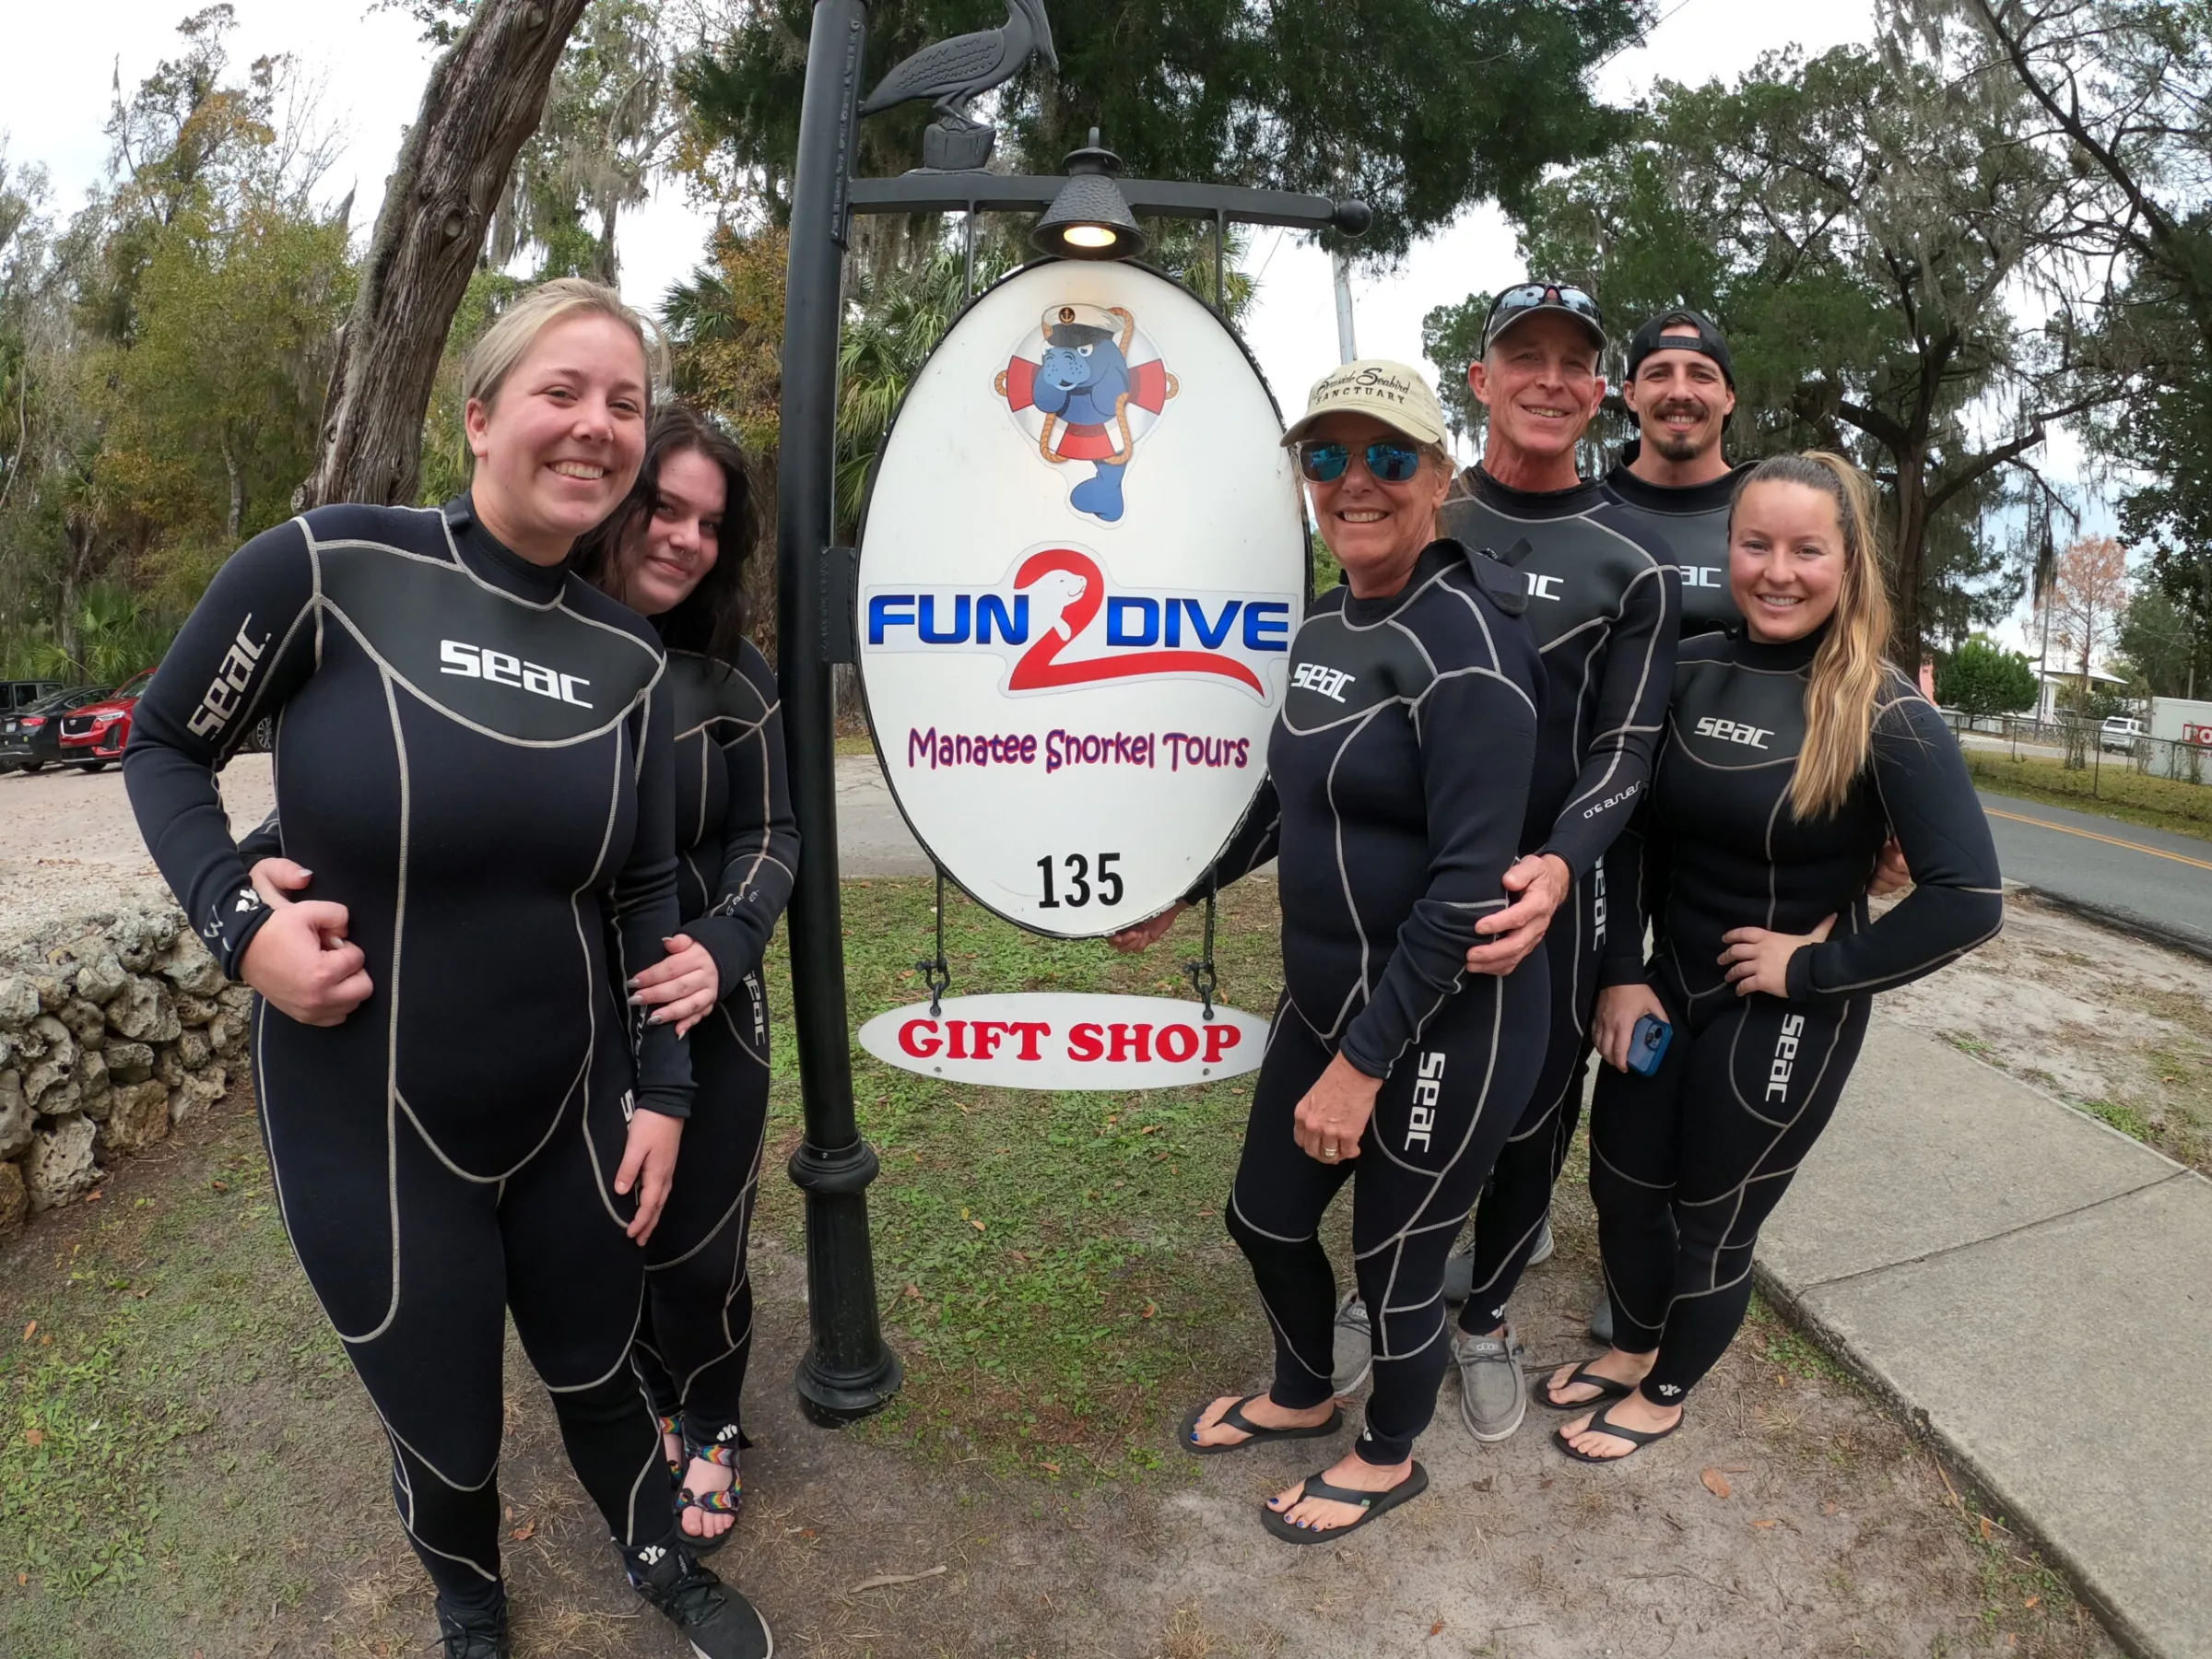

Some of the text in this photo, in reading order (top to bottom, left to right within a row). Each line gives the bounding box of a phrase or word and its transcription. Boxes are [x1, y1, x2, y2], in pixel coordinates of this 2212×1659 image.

[1315, 386, 1405, 405] SANCTUARY
[1356, 368, 1411, 394] Seabird
[187, 612, 272, 741] seac
[441, 640, 594, 709] seac
[1290, 663, 1356, 703] seac
[908, 726, 1251, 773] Manatee Snorkel Tours
[1694, 716, 1775, 749] seac
[1037, 853, 1124, 909] 135
[898, 1019, 1241, 1063] GIFT SHOP
[1765, 1013, 1805, 1103] seac
[1404, 1052, 1446, 1153] seac
